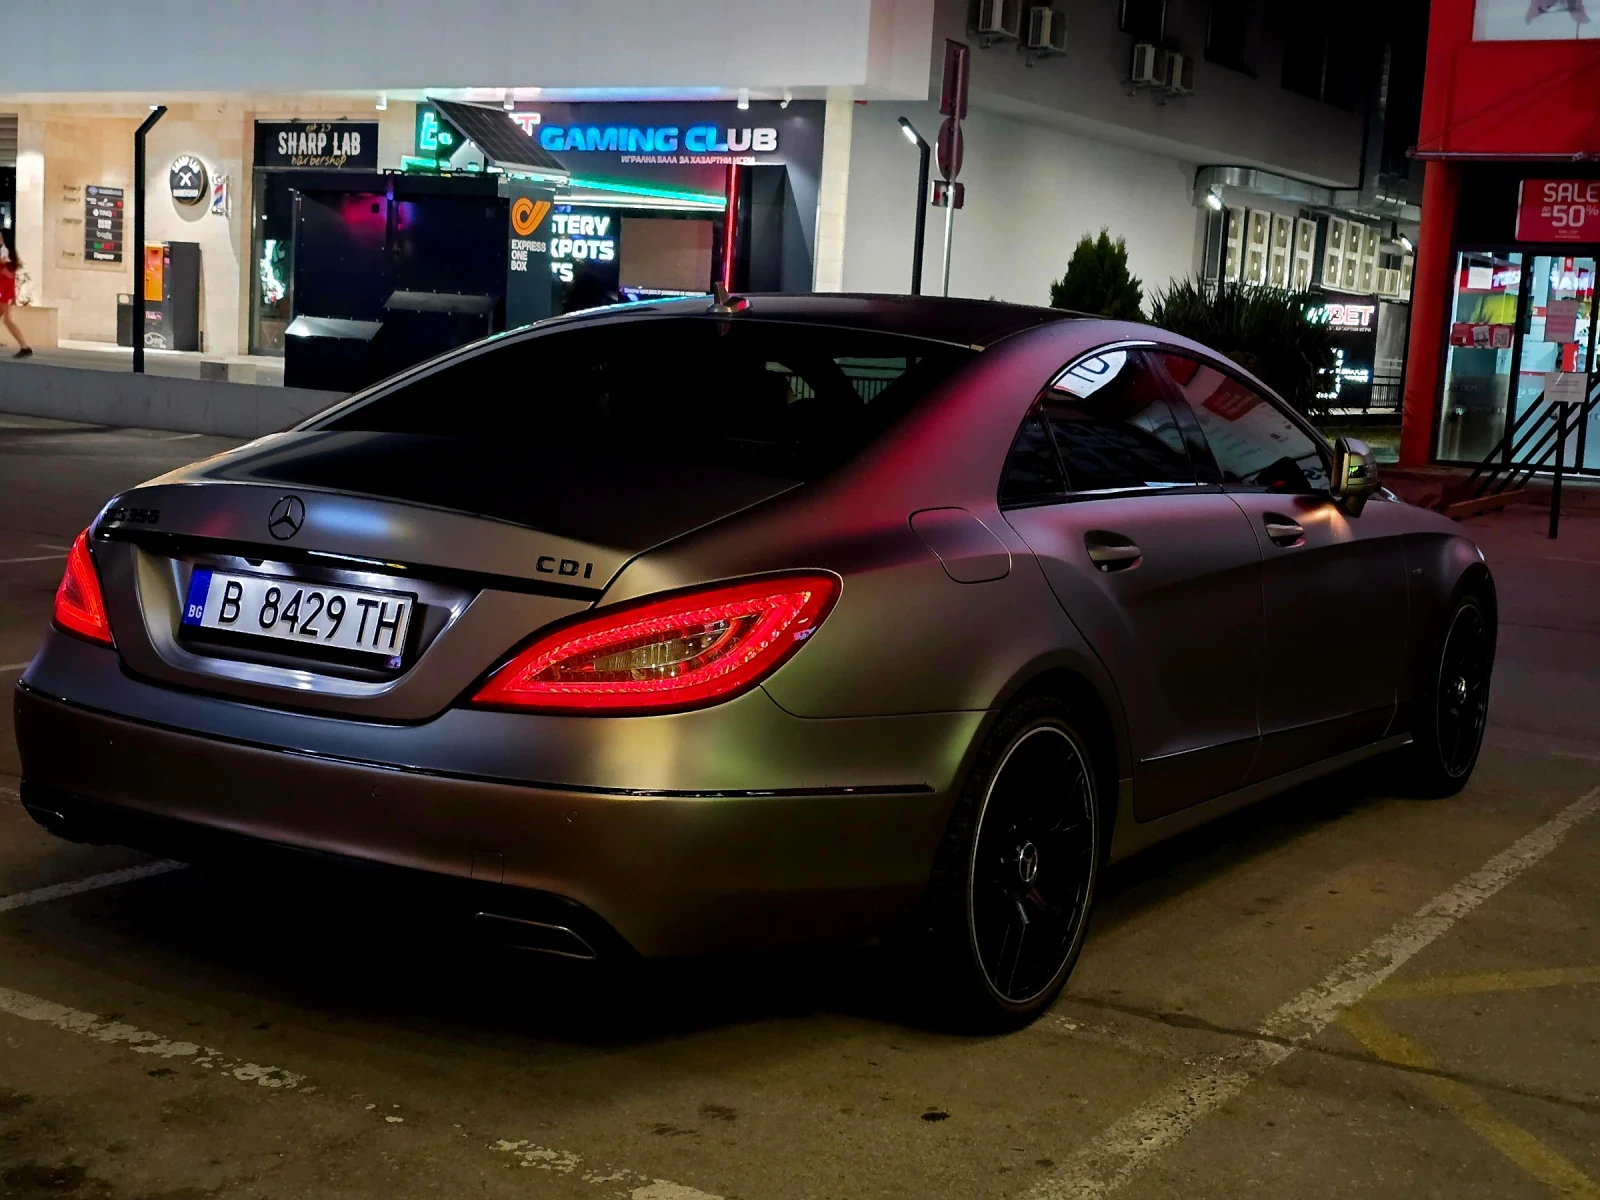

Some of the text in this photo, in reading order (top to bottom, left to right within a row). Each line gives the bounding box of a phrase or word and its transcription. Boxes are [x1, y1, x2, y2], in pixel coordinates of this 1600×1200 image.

[278, 131, 361, 156] SHARP LAB
[540, 126, 778, 152] GAMING CLUB
[291, 154, 347, 168] barbershop
[1543, 182, 1600, 203] SALE
[511, 239, 547, 253] EXPRESS
[511, 250, 528, 261] ONE
[510, 260, 527, 272] BOX
[536, 555, 594, 579] CDI
[188, 604, 204, 619] BG
[217, 580, 406, 648] B 8429 TH
